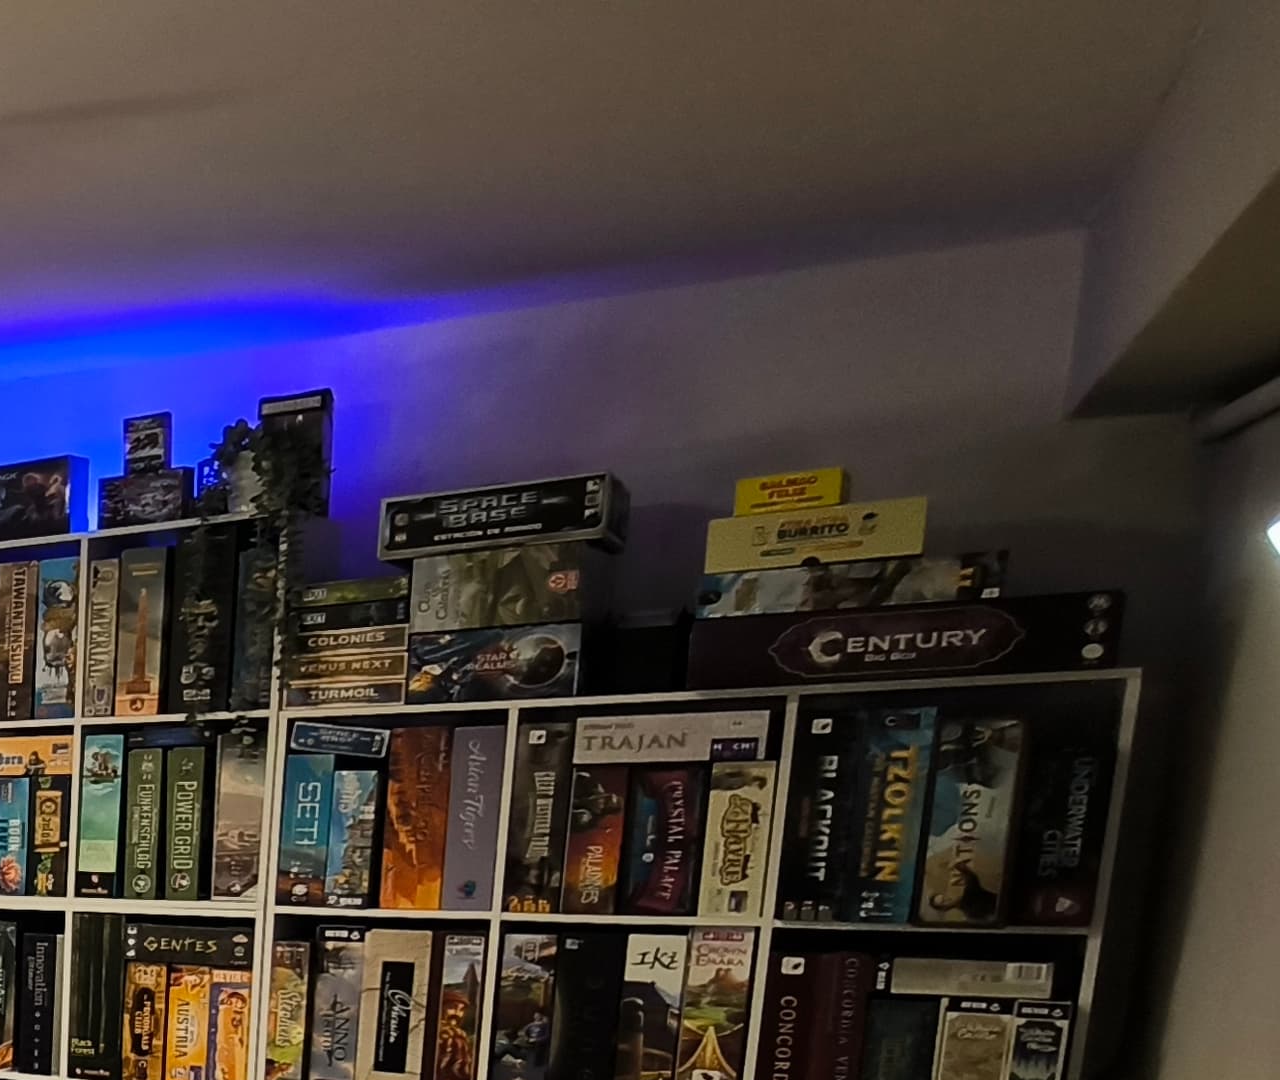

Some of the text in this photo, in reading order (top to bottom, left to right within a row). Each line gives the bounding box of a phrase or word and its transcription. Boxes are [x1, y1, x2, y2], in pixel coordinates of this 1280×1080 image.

[440, 492, 538, 515] SPACE
[443, 506, 527, 528] BASE
[776, 521, 849, 540] BURRITO
[307, 631, 386, 648] COLONIES
[807, 626, 986, 662] CENTURY
[299, 658, 393, 673] VENUS NEXT
[309, 687, 379, 700] TURMOIL
[583, 731, 688, 752] TRAJAN
[8, 818, 22, 852] BOON
[137, 783, 155, 870] FUNKENSCHLAG
[174, 780, 197, 872] POWER GRID
[294, 781, 324, 846] SETI
[806, 754, 839, 883] BLACKOUT
[1062, 753, 1092, 869] UNDERWATER
[654, 781, 685, 901] CRYSTAL PALACE
[950, 786, 983, 888] NATIONS
[144, 937, 218, 953] GENTES
[34, 941, 50, 1007] Innovation
[174, 998, 191, 1060] AUSTRIA
[333, 1000, 351, 1062] ANNO
